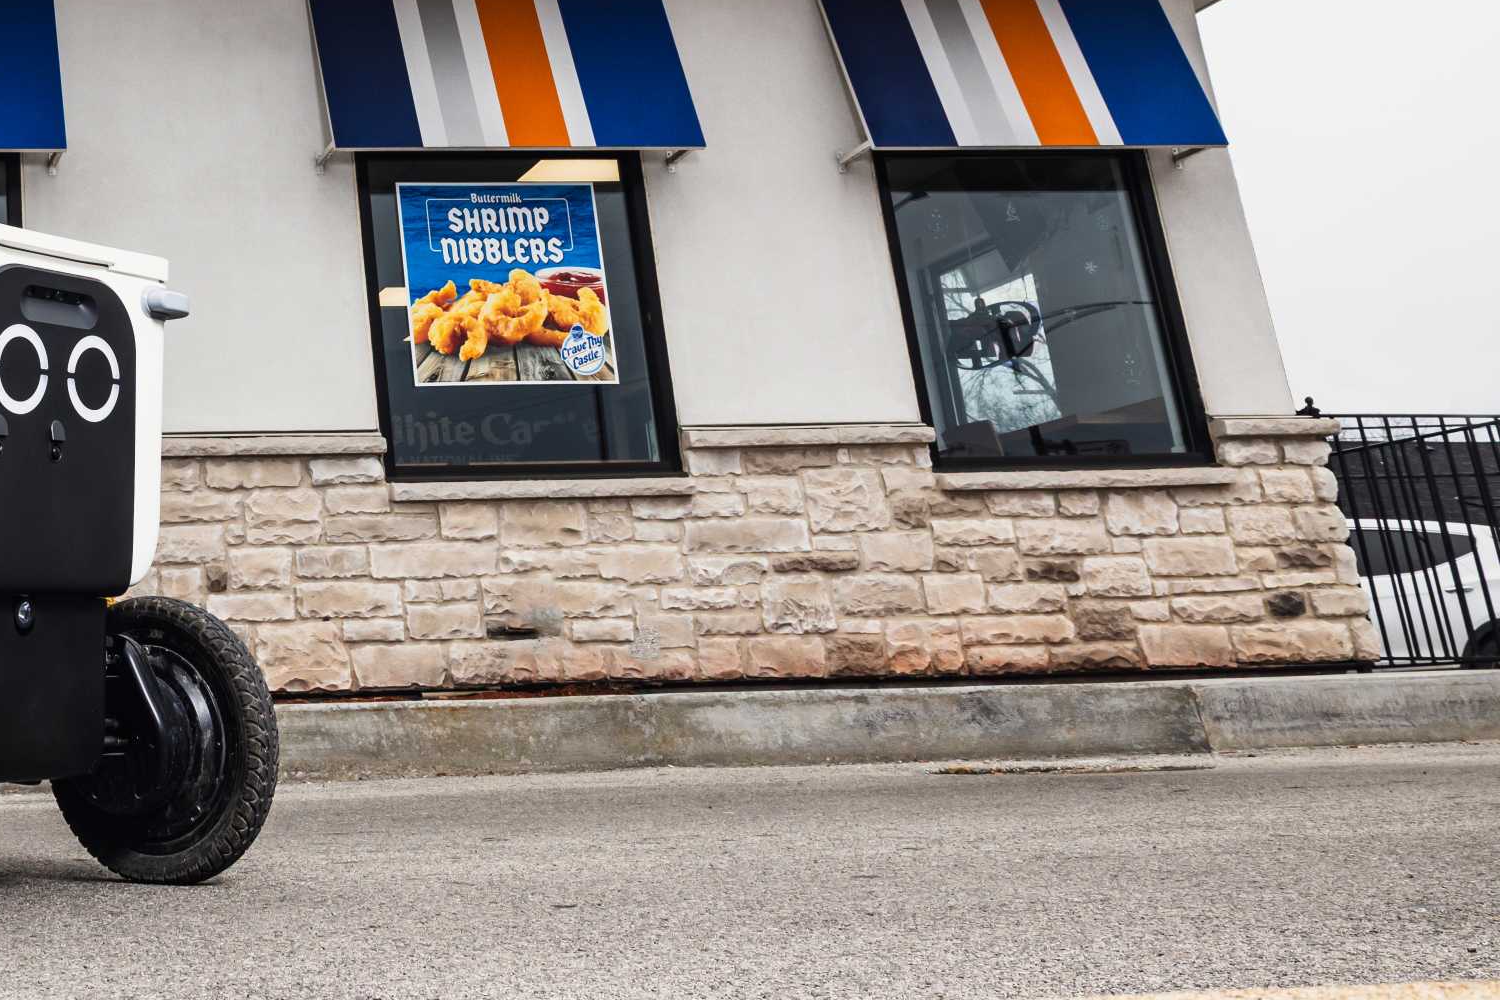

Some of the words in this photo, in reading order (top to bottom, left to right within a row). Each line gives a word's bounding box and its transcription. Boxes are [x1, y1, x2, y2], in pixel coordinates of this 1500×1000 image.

[470, 193, 523, 204] Buttermilk
[447, 206, 549, 234] SHRIMP
[440, 237, 565, 264] NIBBLERS
[561, 342, 587, 360] Crave
[587, 336, 603, 349] Thy
[573, 350, 599, 369] Castle
